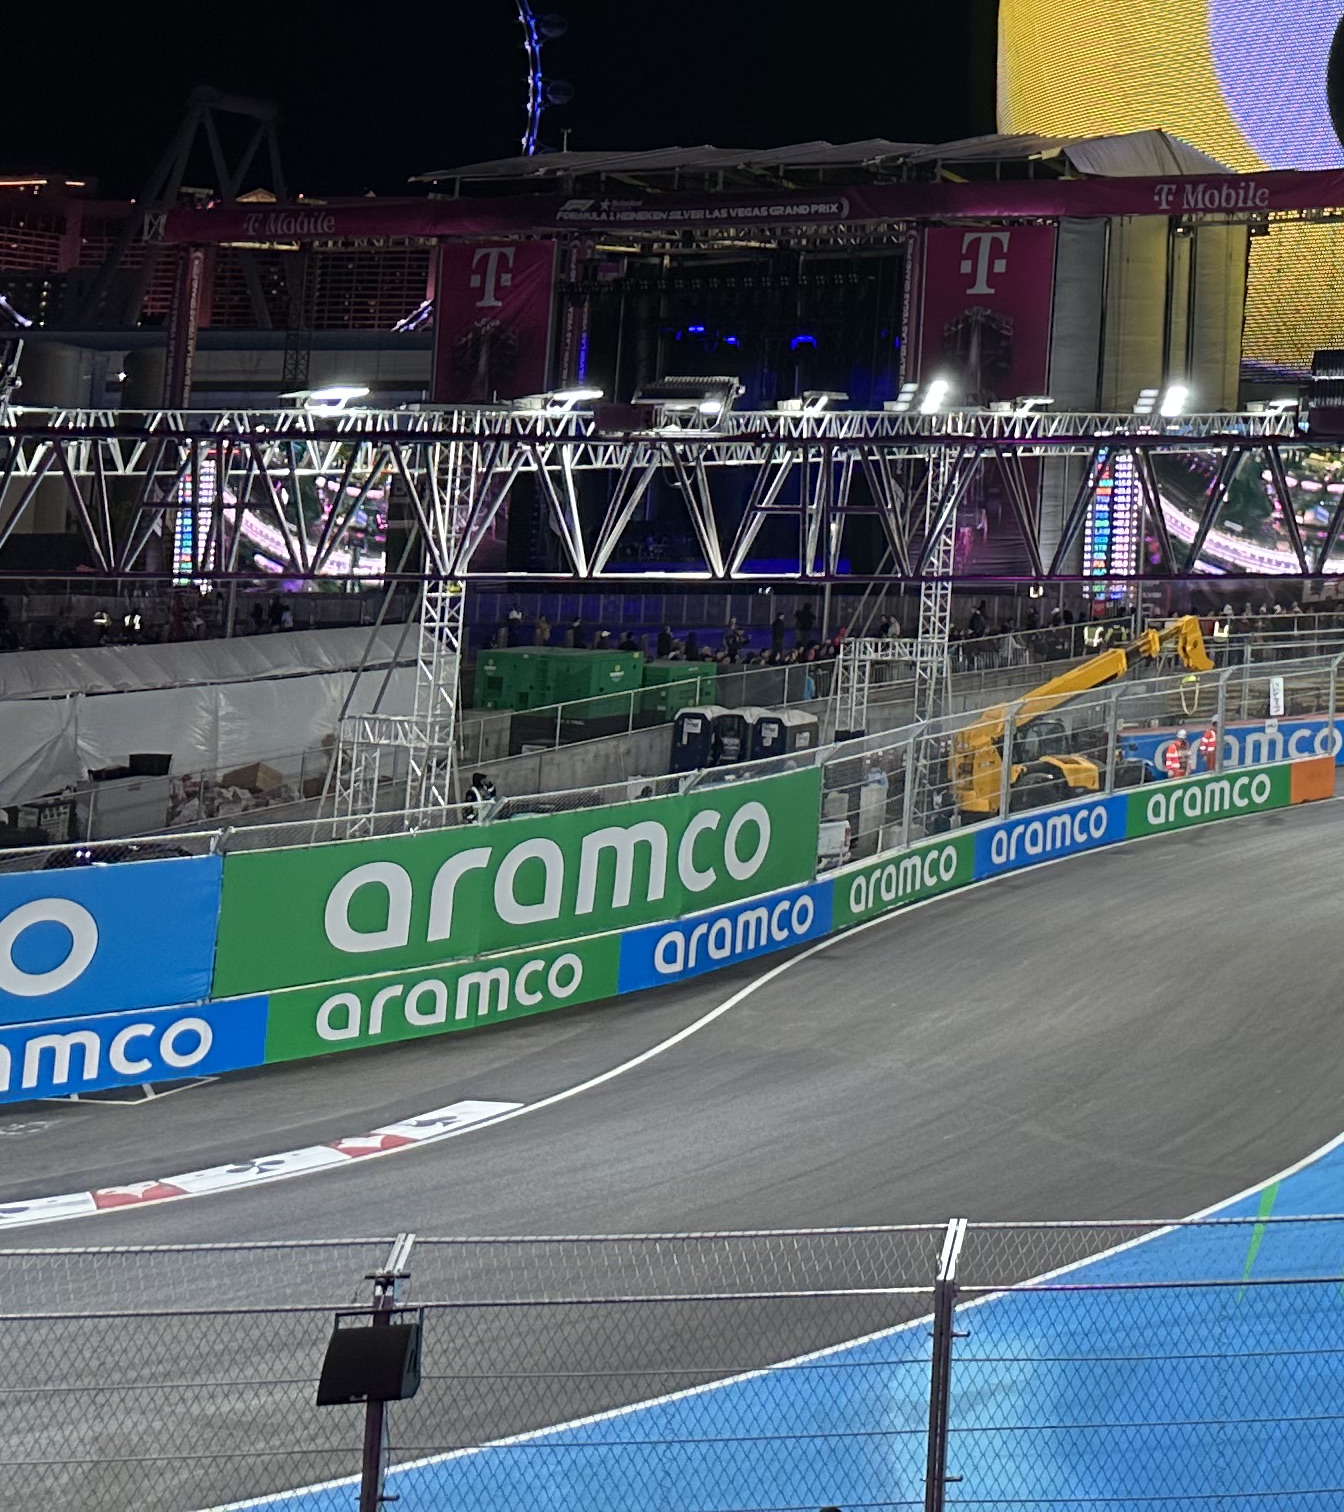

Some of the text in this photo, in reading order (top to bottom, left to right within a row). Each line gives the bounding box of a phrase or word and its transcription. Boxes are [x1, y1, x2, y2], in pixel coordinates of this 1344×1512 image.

[265, 211, 336, 235] Mobile
[706, 208, 728, 219] LAS
[729, 206, 768, 218] VEGAS
[769, 204, 810, 216] GRAND
[811, 201, 840, 214] PRIX
[1183, 182, 1270, 209] Mobile
[470, 246, 517, 307] T
[961, 231, 1011, 294] T
[1147, 773, 1271, 826] aramco
[991, 805, 1107, 865] aramco
[325, 801, 771, 953] aramco
[850, 845, 957, 913] aramco
[654, 894, 814, 974] aramco
[316, 953, 583, 1041] aramco
